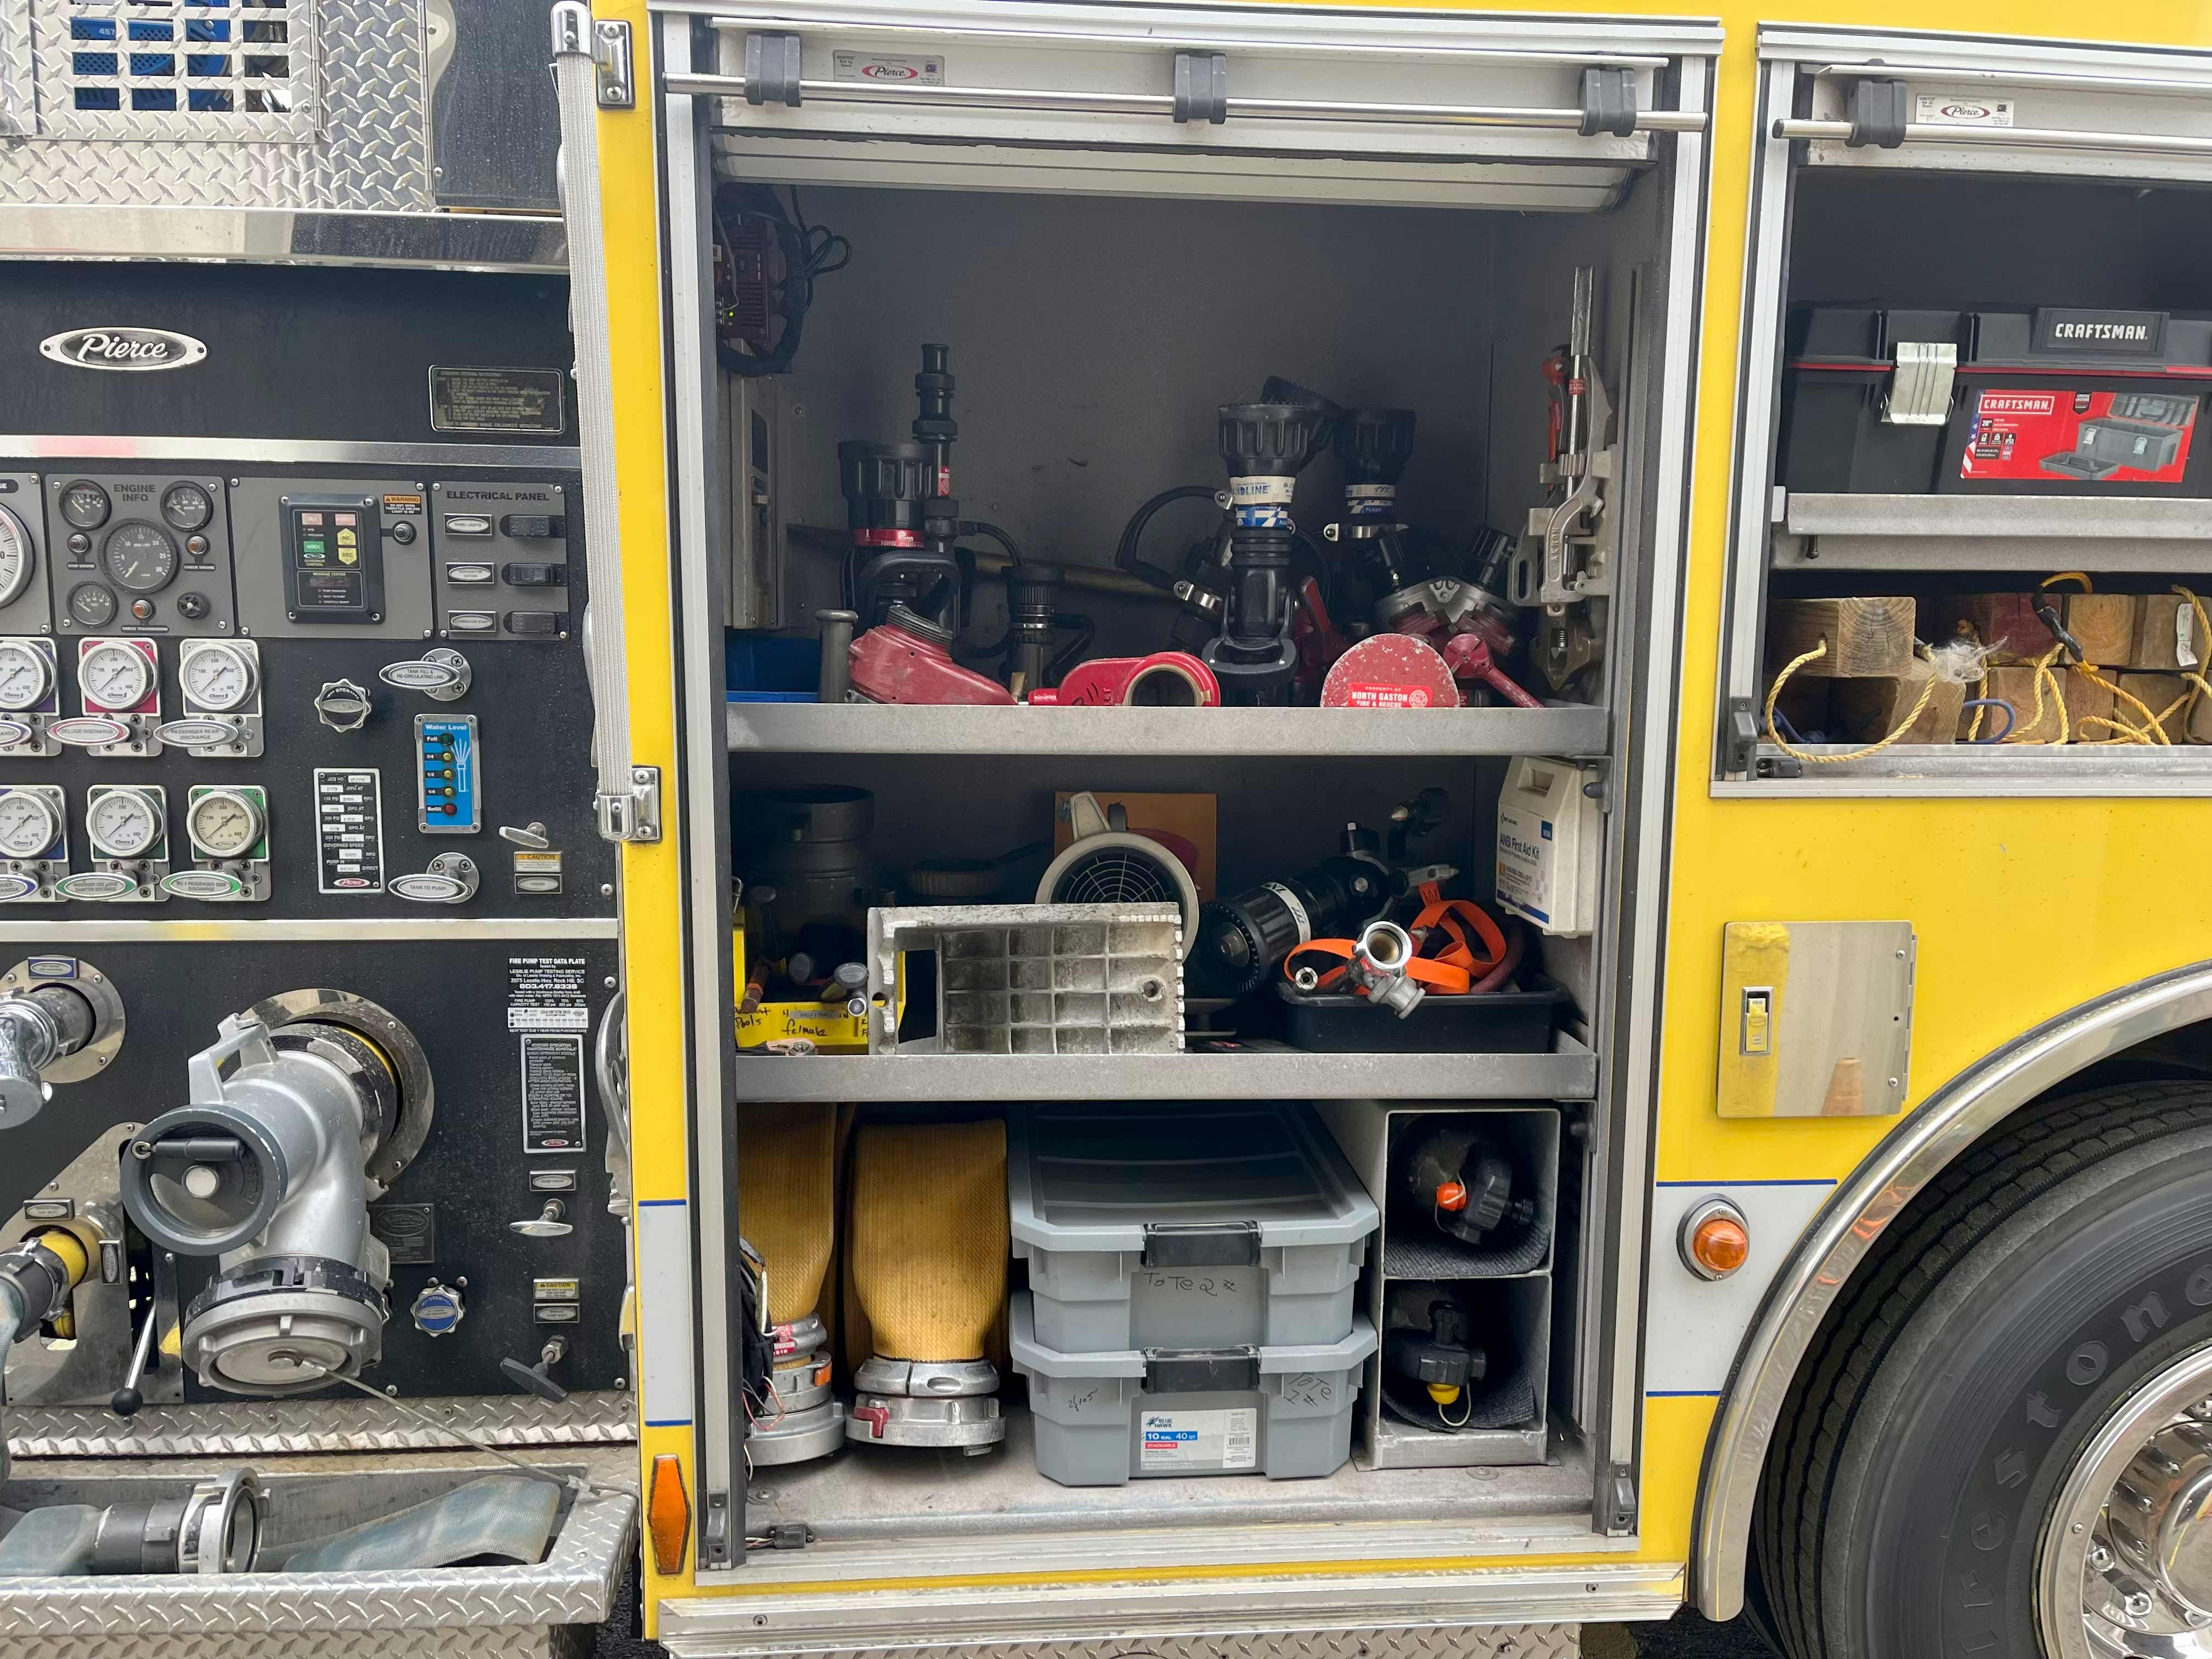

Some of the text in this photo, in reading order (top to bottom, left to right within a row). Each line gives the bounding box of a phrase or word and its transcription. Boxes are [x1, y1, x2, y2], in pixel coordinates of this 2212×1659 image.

[874, 66, 904, 76] Pierce
[1951, 106, 1978, 116] Pierce
[2055, 323, 2147, 340] CRAFTSMAN
[77, 334, 168, 362] Pierce
[1984, 399, 2049, 410] CRAFTSMAN
[114, 484, 156, 493] ENGINE
[447, 491, 549, 501] ELECTRICAL PANEL
[1551, 527, 1560, 560] AKRON
[1352, 692, 1408, 702] NORTH GASTON
[1500, 833, 1511, 847] ANSI
[1512, 837, 1521, 852] First
[1523, 843, 1531, 856] Aid
